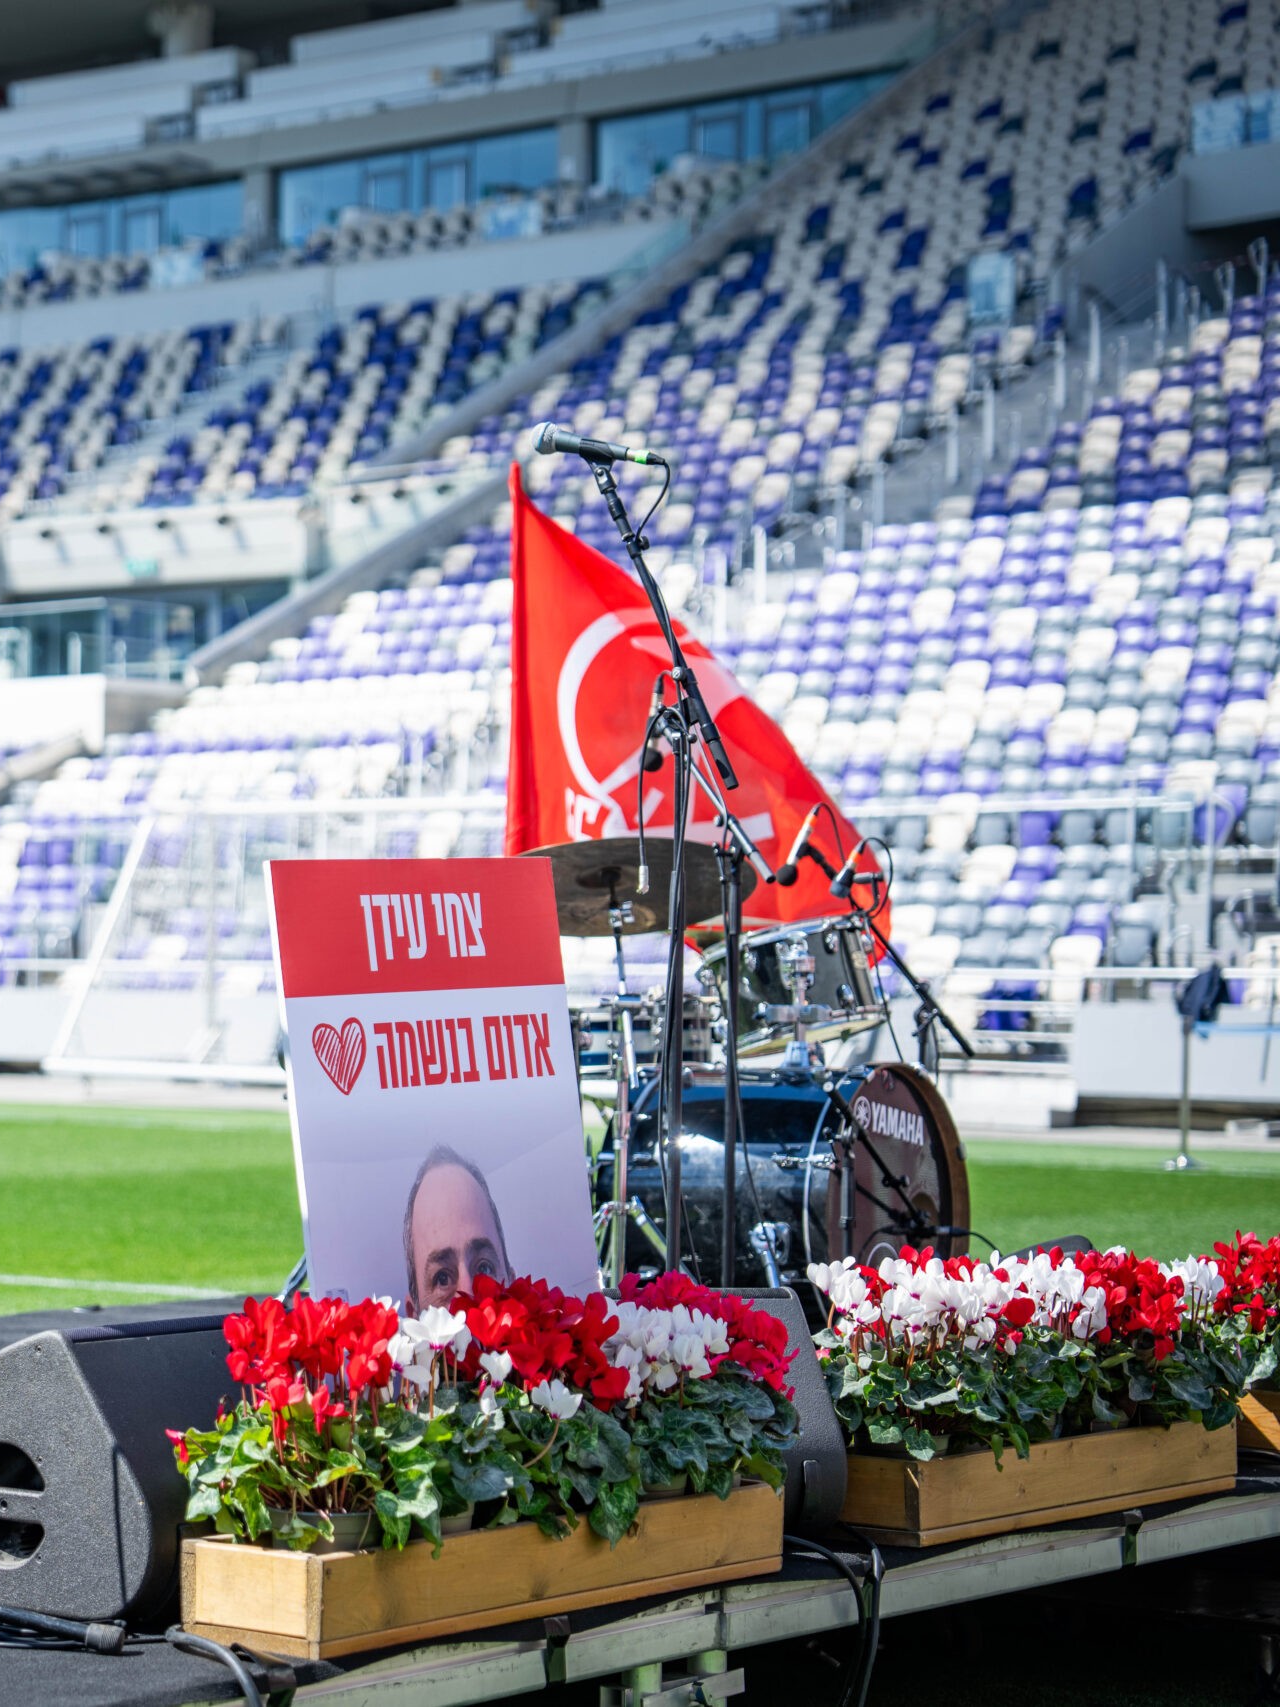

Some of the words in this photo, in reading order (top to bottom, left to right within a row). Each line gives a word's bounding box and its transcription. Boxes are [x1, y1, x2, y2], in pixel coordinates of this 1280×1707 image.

[360, 893, 428, 972] עידן
[431, 892, 487, 958] צחי
[373, 1017, 480, 1090] בנשמה
[482, 1012, 556, 1081] אדום
[871, 1101, 924, 1147] YAMAHA
